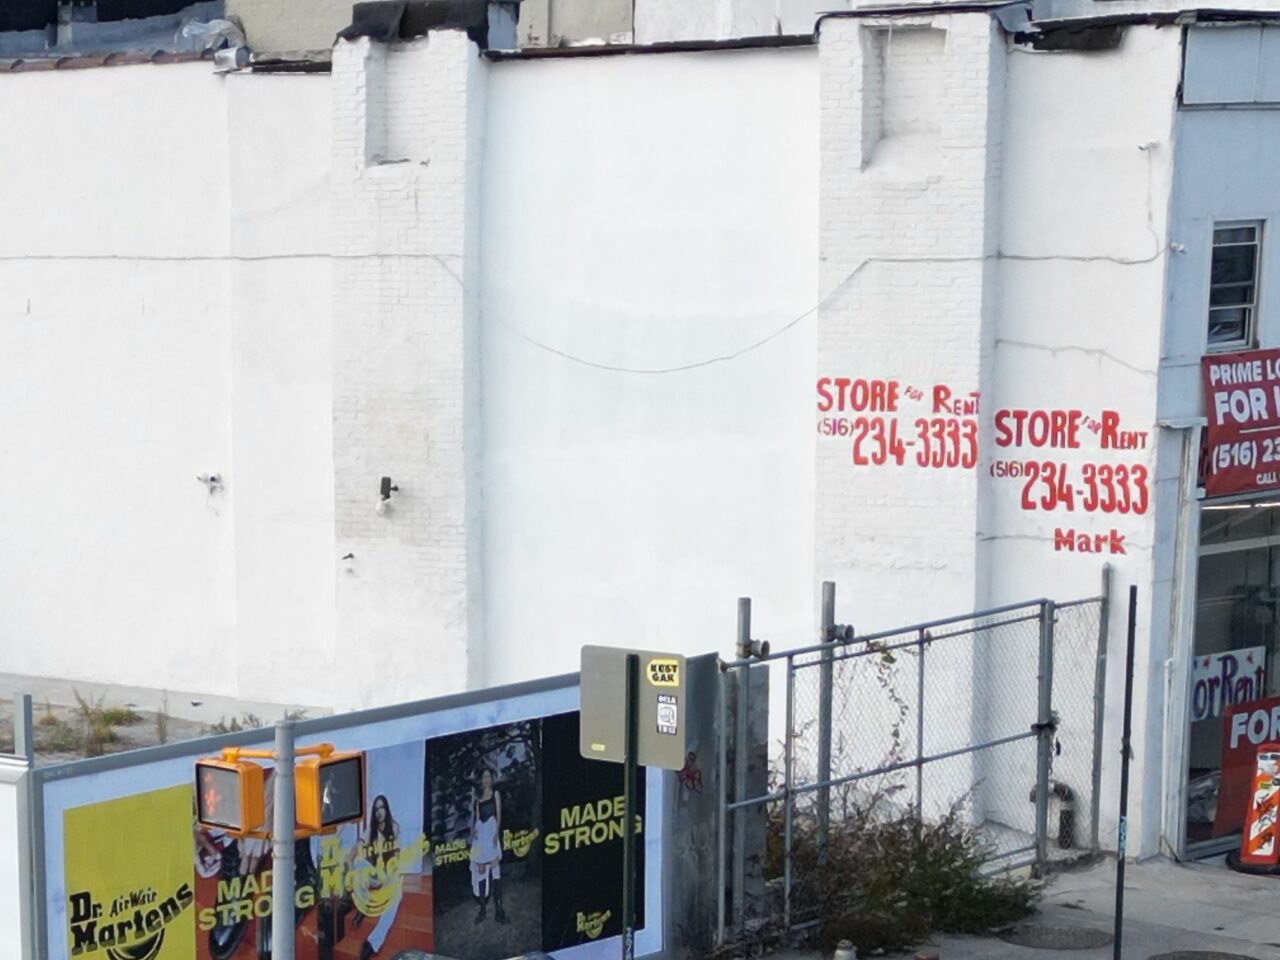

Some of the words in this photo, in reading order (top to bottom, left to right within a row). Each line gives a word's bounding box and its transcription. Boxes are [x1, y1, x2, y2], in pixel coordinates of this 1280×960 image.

[1209, 360, 1263, 387] PRIME
[816, 377, 899, 412] STORE
[1214, 387, 1269, 426] FOR
[994, 409, 1082, 449] STORE
[1212, 440, 1258, 475] (516)
[1054, 527, 1127, 555] Mark
[560, 795, 626, 829] MADE
[435, 838, 467, 855] MADE
[69, 891, 103, 923] Dr.
[70, 882, 193, 956] Martens
[199, 885, 315, 931] STROG
